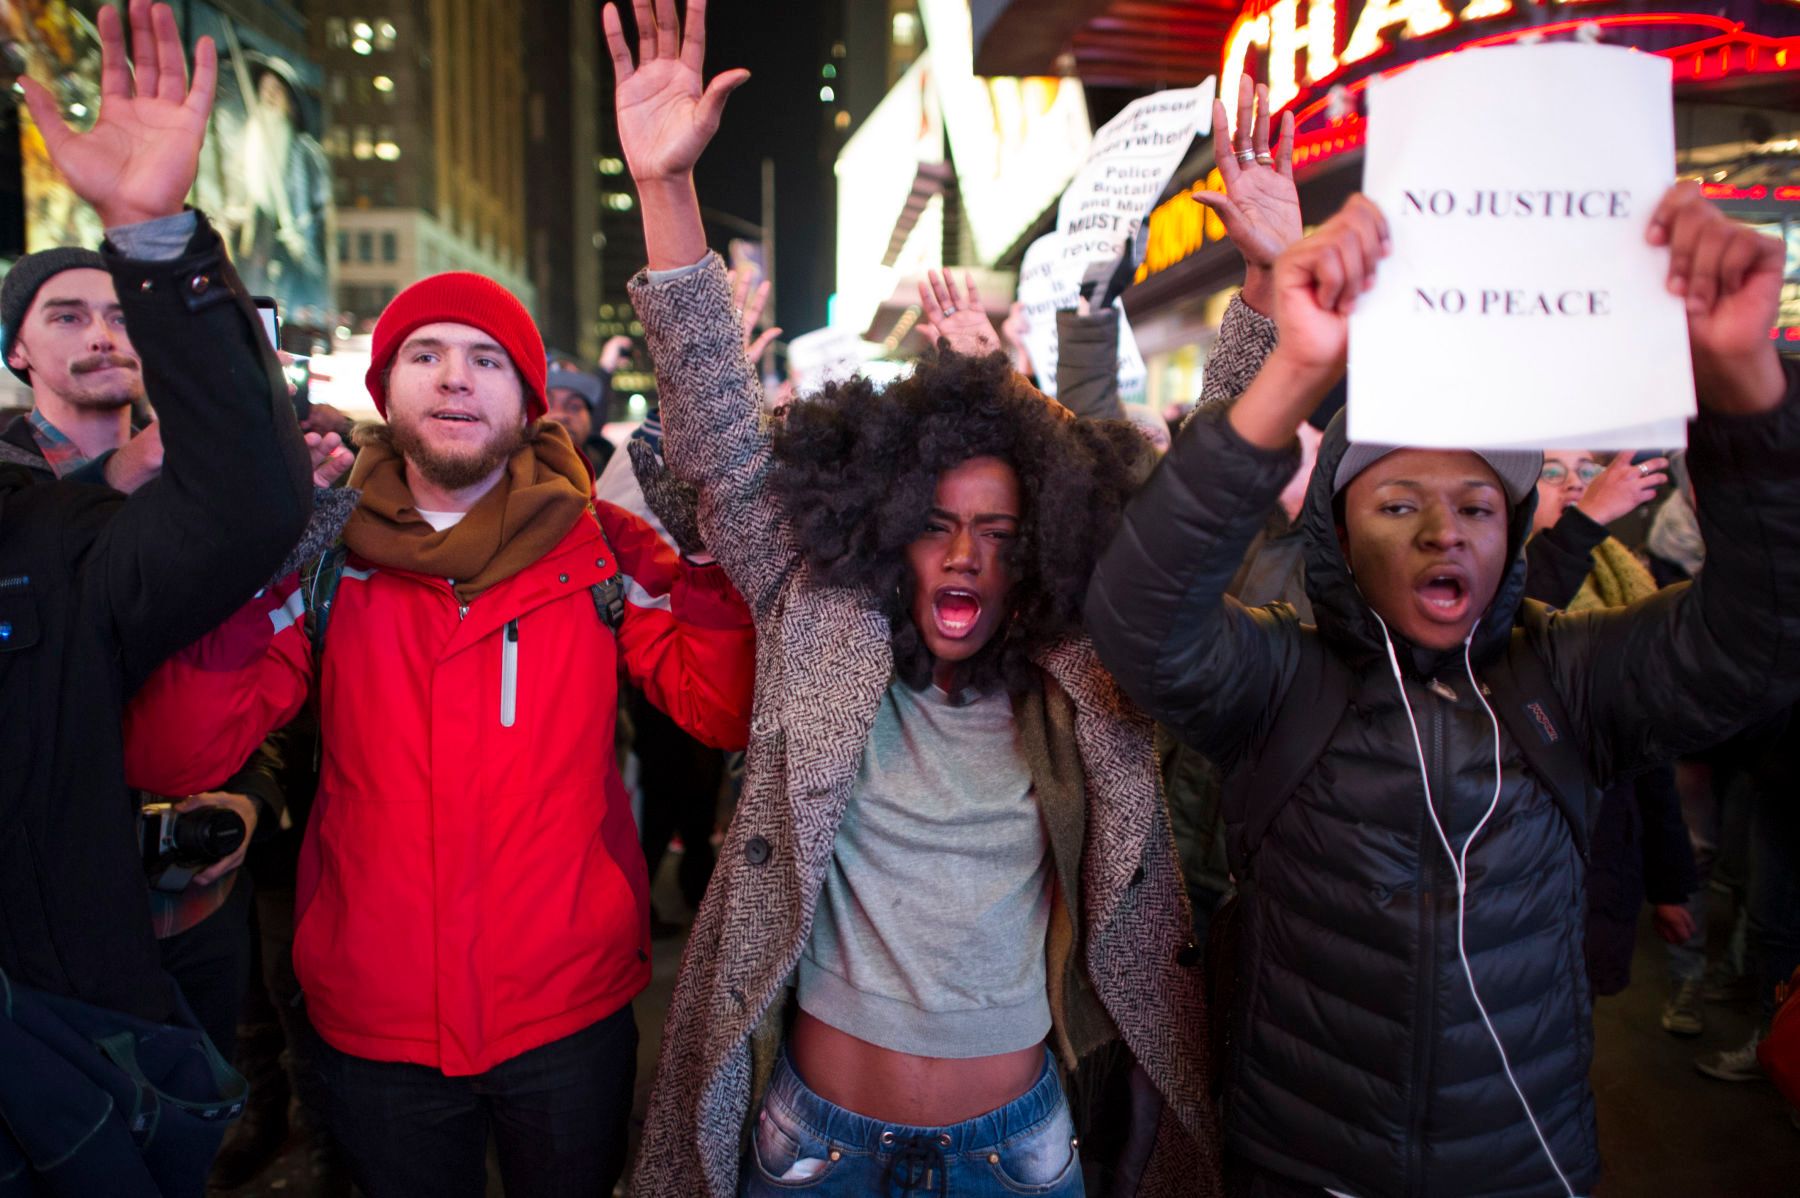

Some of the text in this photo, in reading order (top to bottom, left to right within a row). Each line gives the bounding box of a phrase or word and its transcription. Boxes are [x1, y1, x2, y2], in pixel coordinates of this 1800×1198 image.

[1219, 0, 1514, 141] CHA
[1106, 166, 1162, 179] Police
[1402, 189, 1632, 218] NO JUSTICE
[1068, 213, 1121, 235] MUST
[1415, 286, 1612, 316] NO PEACE
